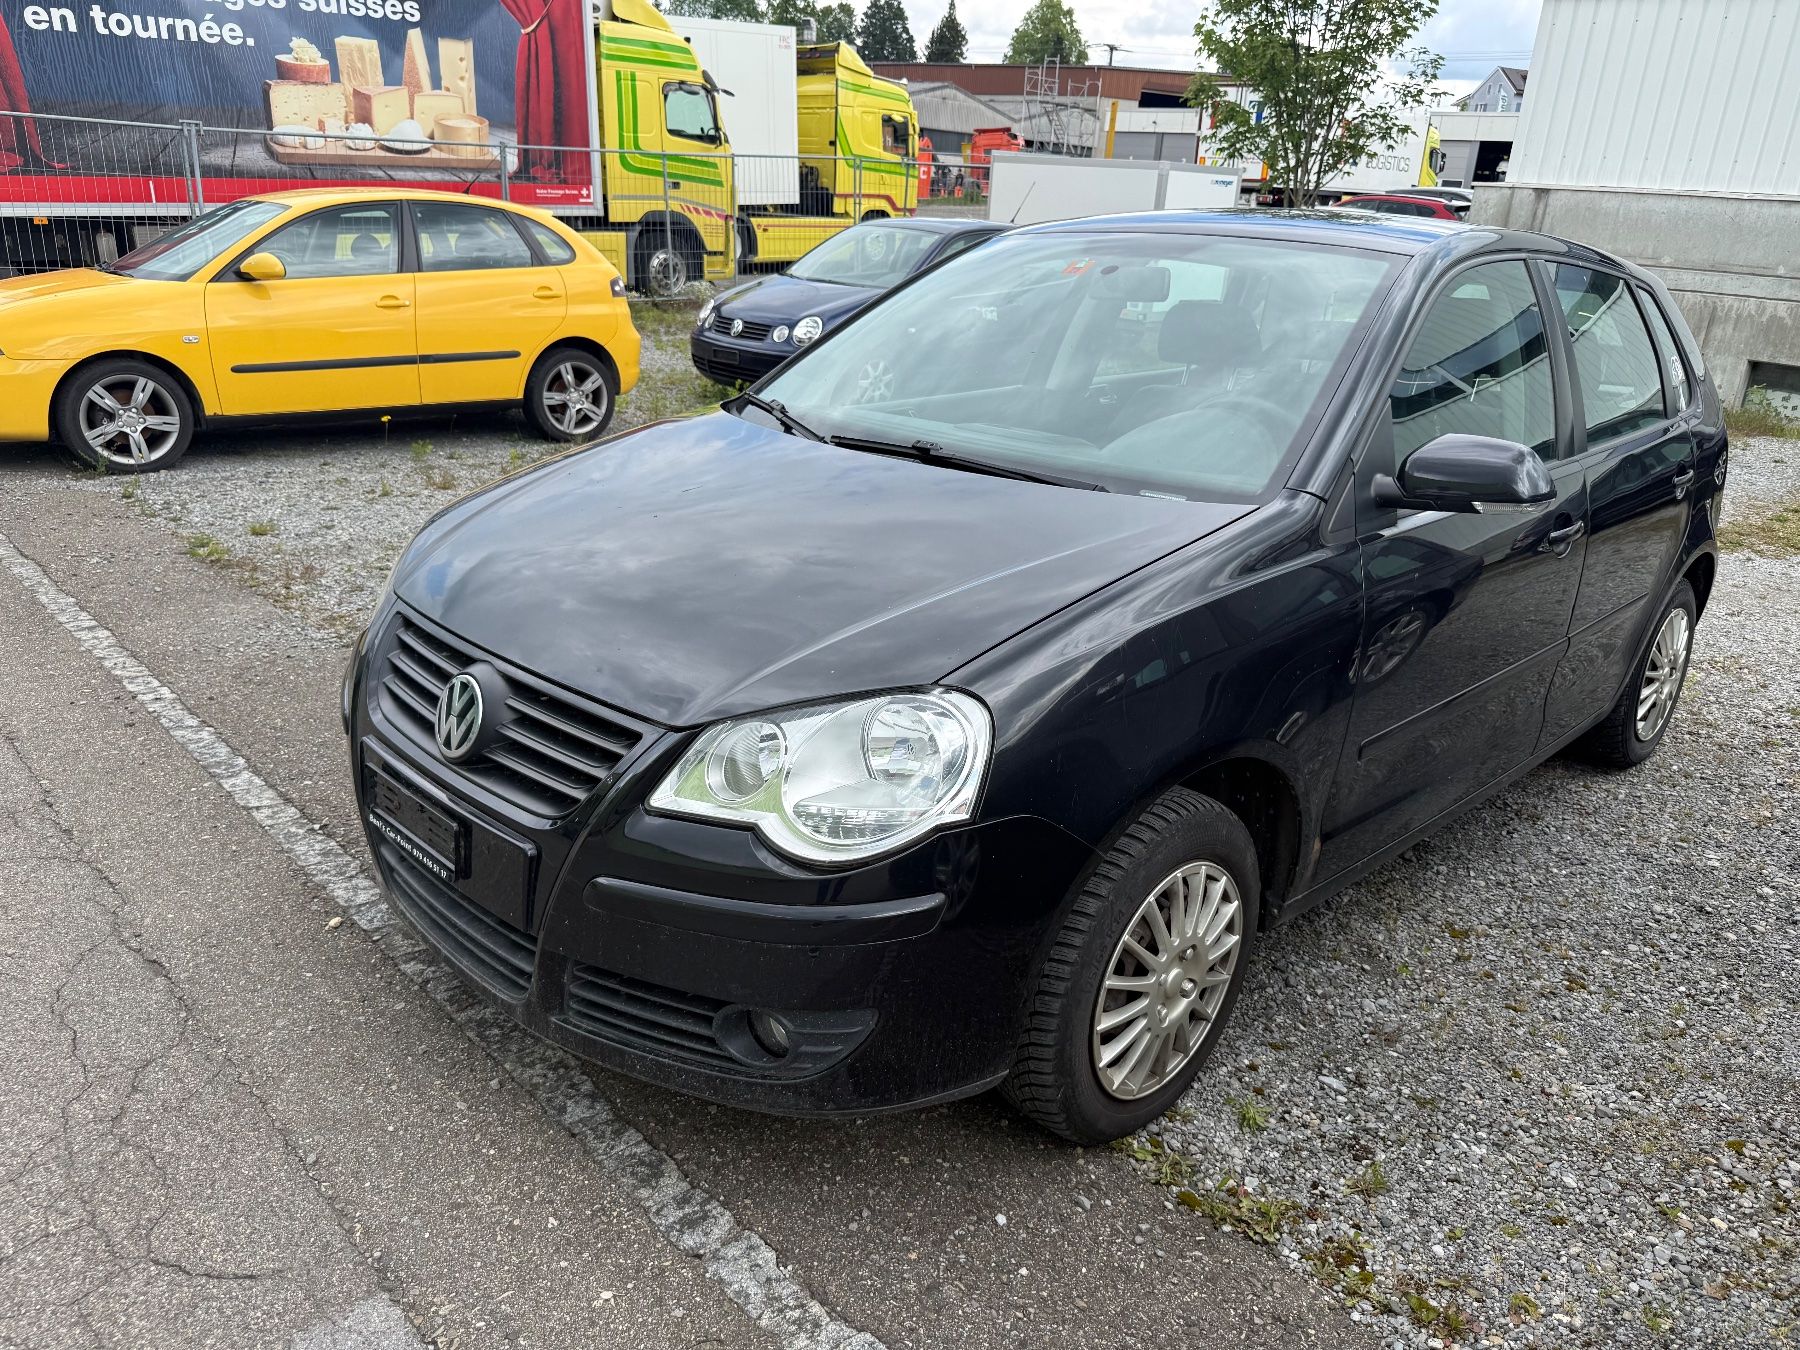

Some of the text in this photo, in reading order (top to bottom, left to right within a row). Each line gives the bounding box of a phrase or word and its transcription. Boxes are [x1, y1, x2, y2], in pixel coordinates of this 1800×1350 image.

[24, 5, 255, 47] en tournée.
[298, 0, 420, 22] suisses
